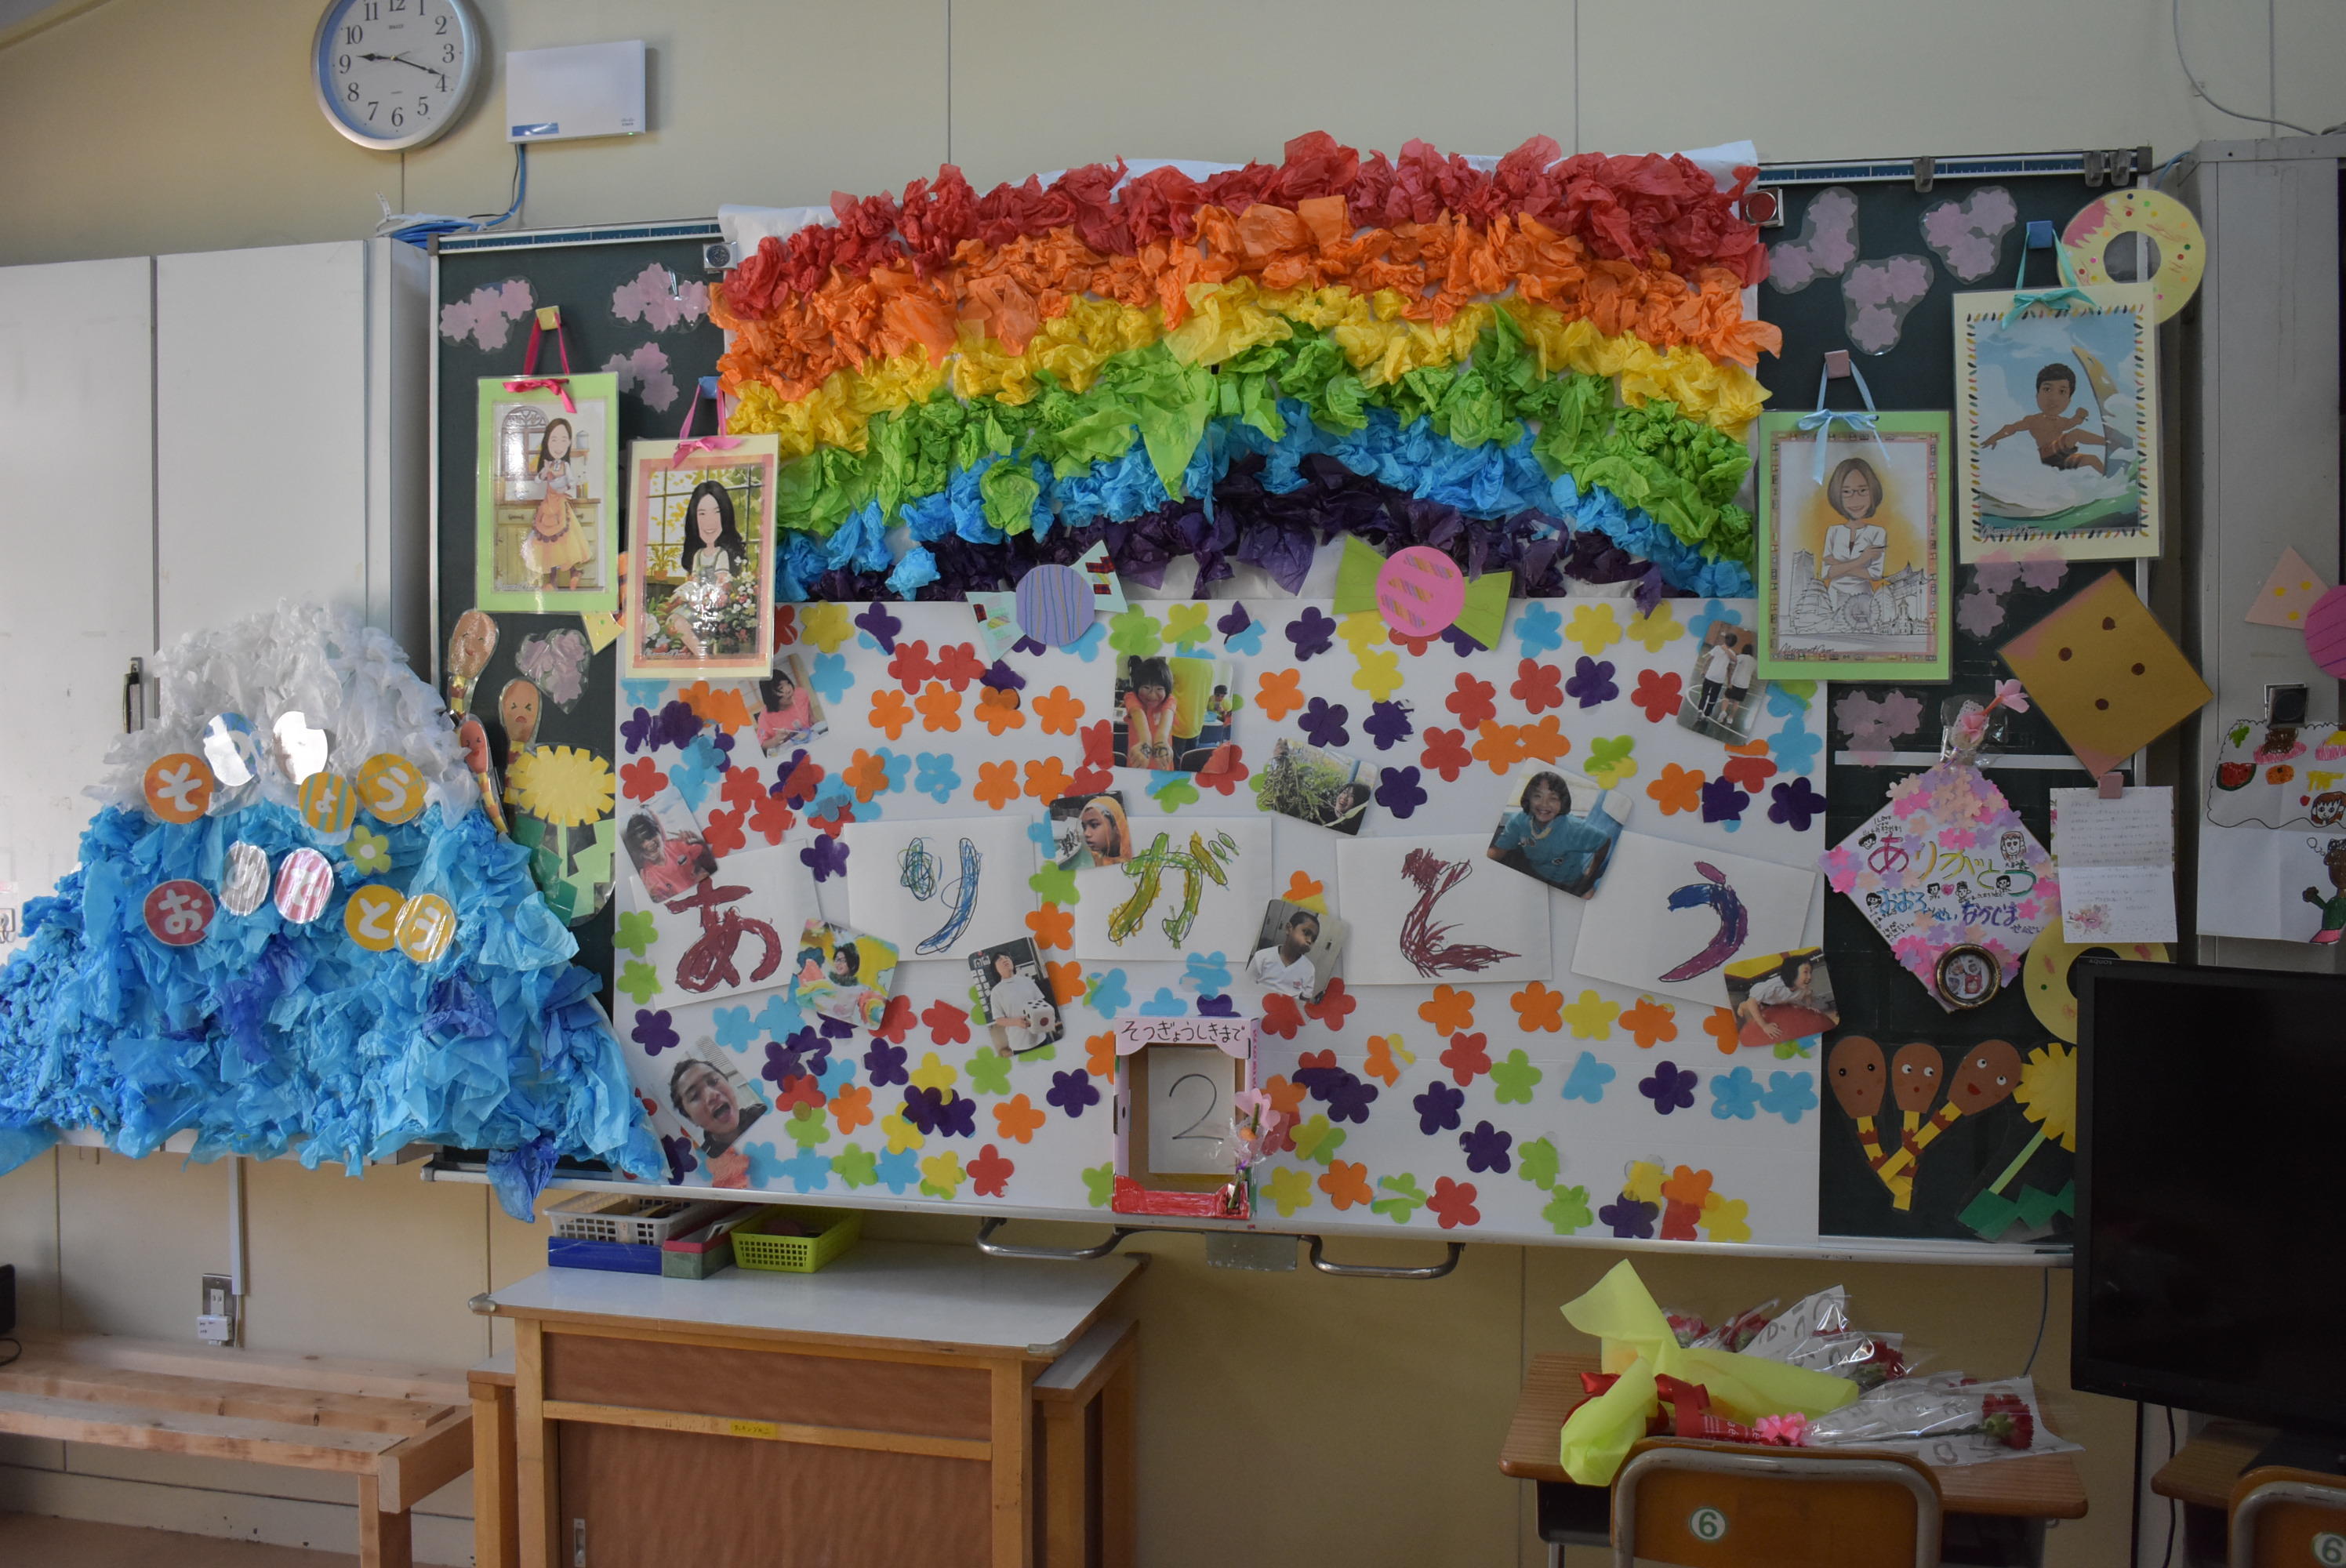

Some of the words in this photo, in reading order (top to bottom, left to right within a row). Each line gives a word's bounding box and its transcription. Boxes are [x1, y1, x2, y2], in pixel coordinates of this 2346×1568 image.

[364, 2, 379, 21] 11
[419, 0, 426, 16] 1
[345, 25, 363, 45] 10
[435, 16, 447, 34] 2
[442, 43, 455, 63] 3
[339, 54, 351, 74] 9
[347, 82, 359, 101] 8
[435, 74, 447, 93] 4
[368, 100, 379, 121] 7
[417, 96, 429, 116] 5
[391, 107, 404, 127] 6
[1121, 1021, 1246, 1043] そつぎょうしきまで
[1169, 1073, 1225, 1140] 2
[1699, 1512, 1717, 1537] 6
[2322, 1537, 2344, 1563] 6
